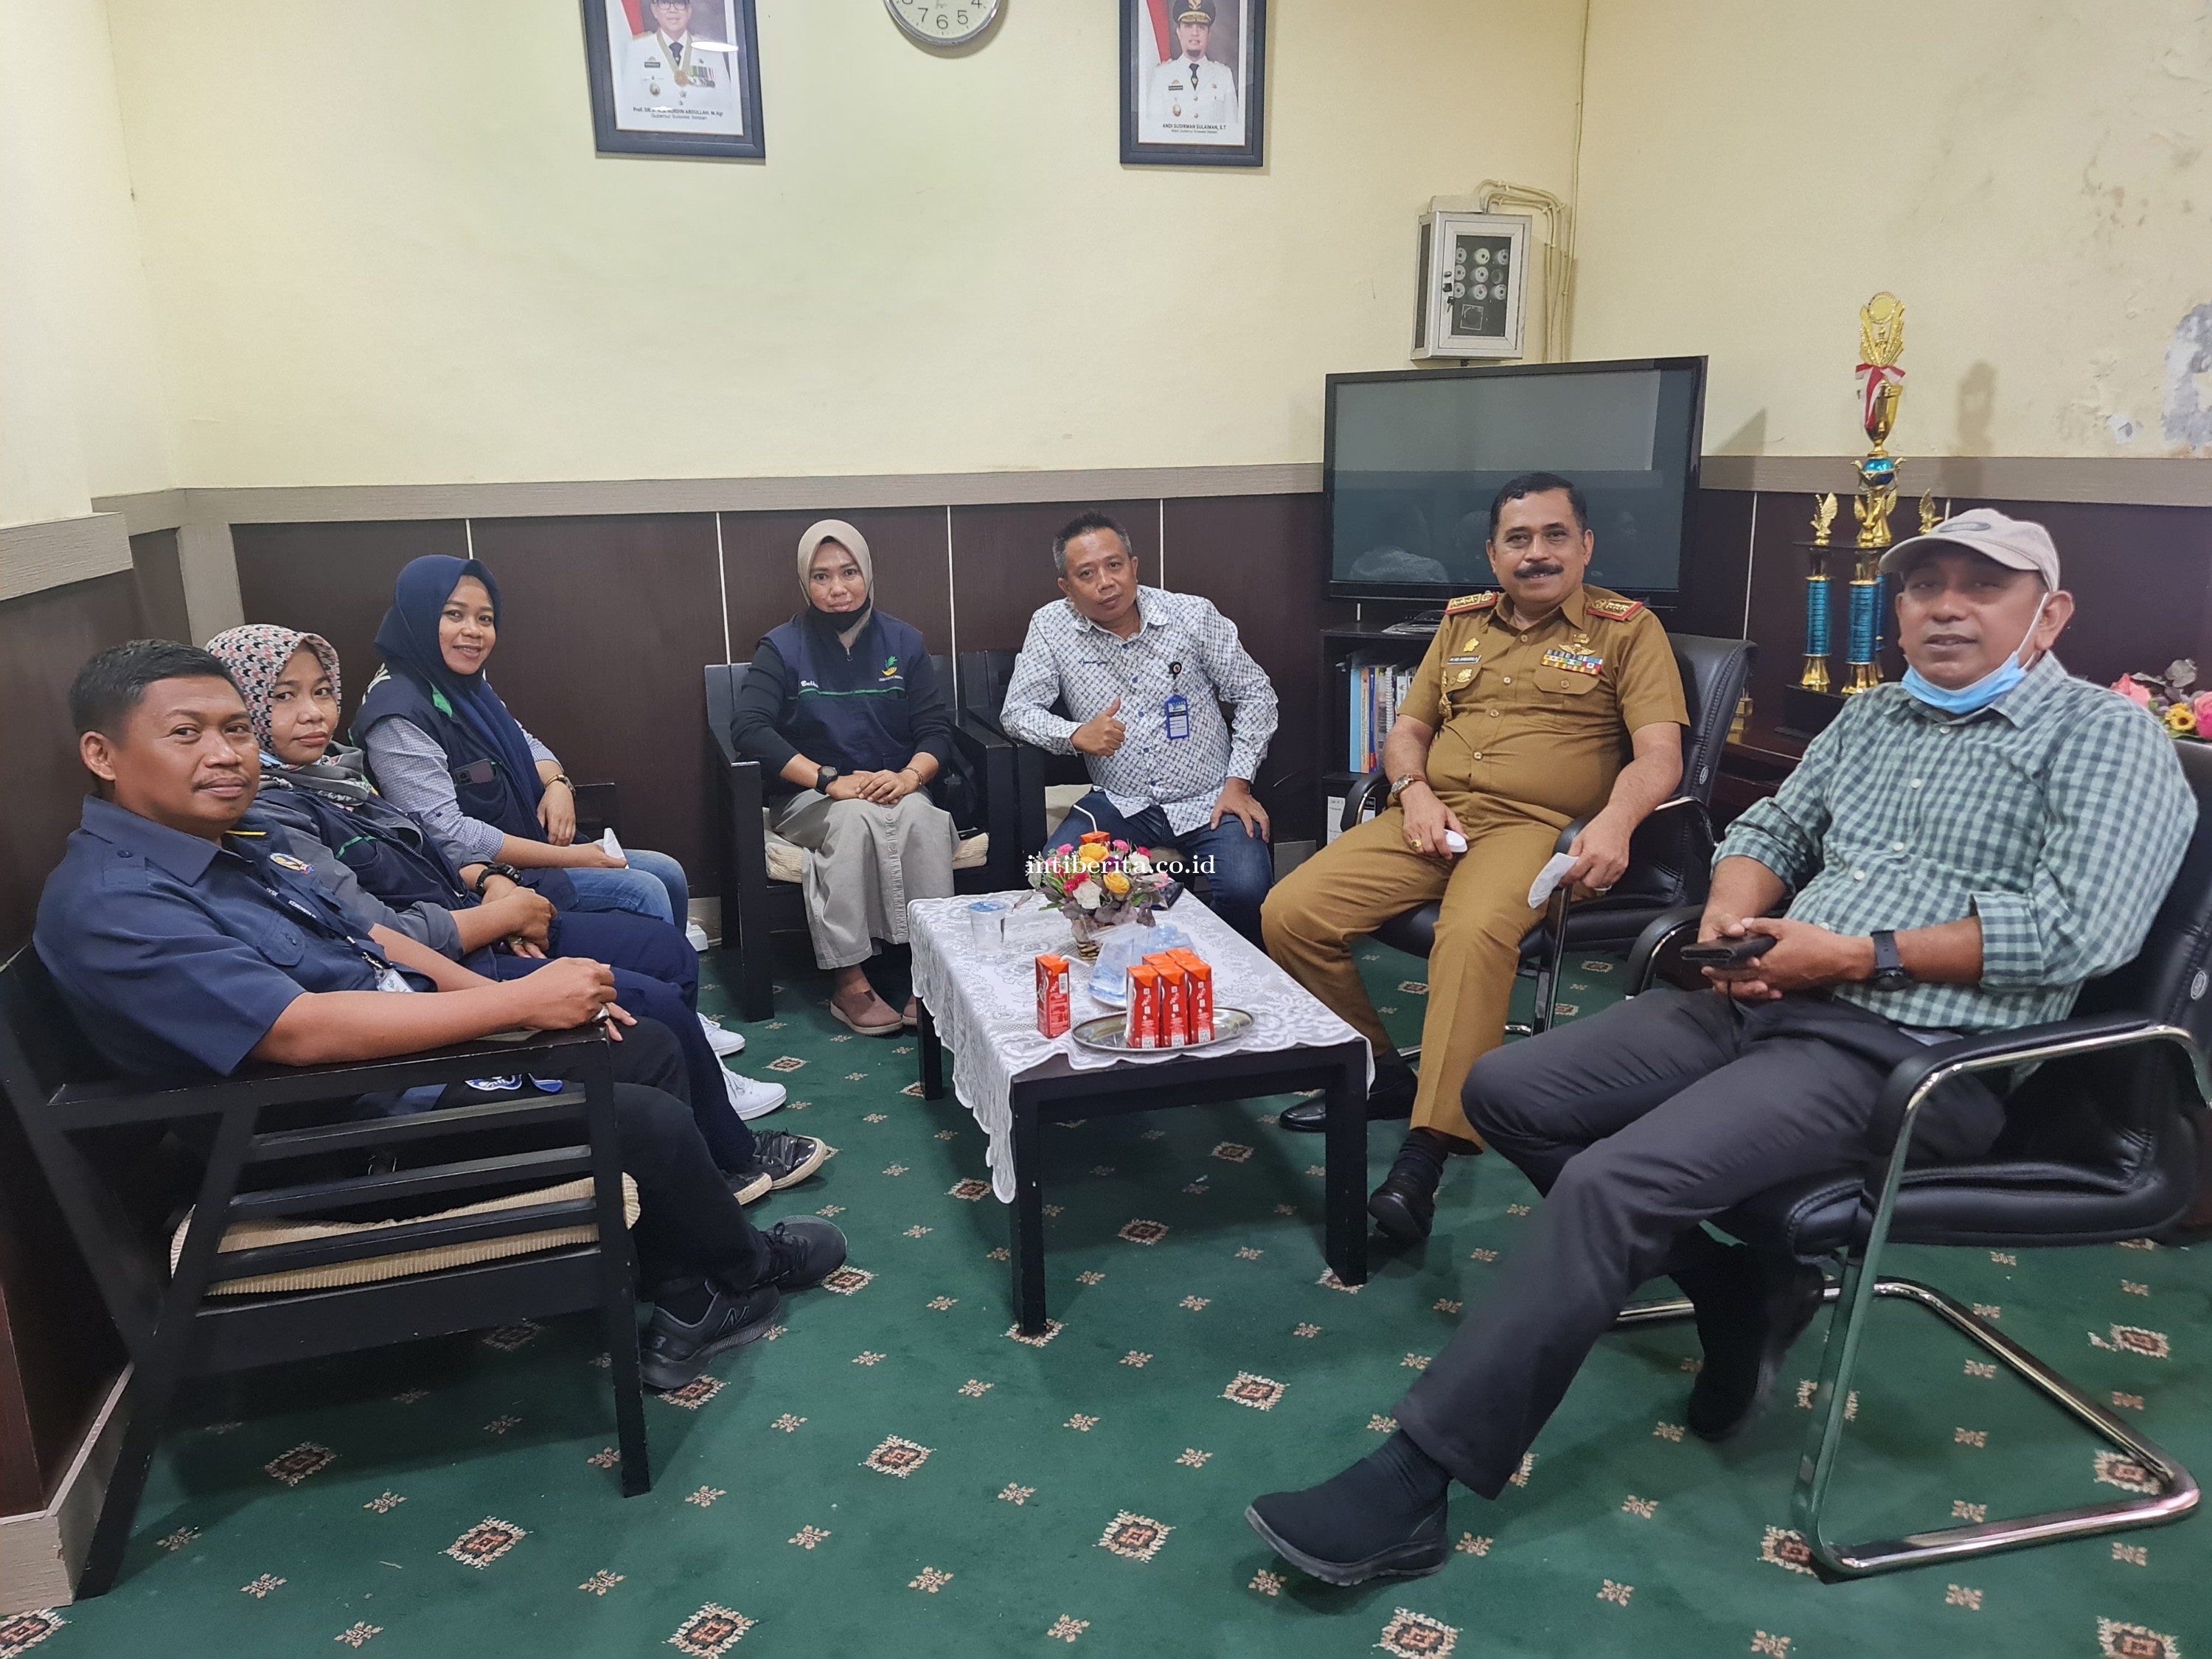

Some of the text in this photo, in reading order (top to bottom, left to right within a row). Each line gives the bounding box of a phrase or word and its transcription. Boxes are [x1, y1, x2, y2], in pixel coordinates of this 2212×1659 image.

[917, 7, 928, 23] 7
[936, 14, 949, 30] 6
[957, 10, 969, 25] 5
